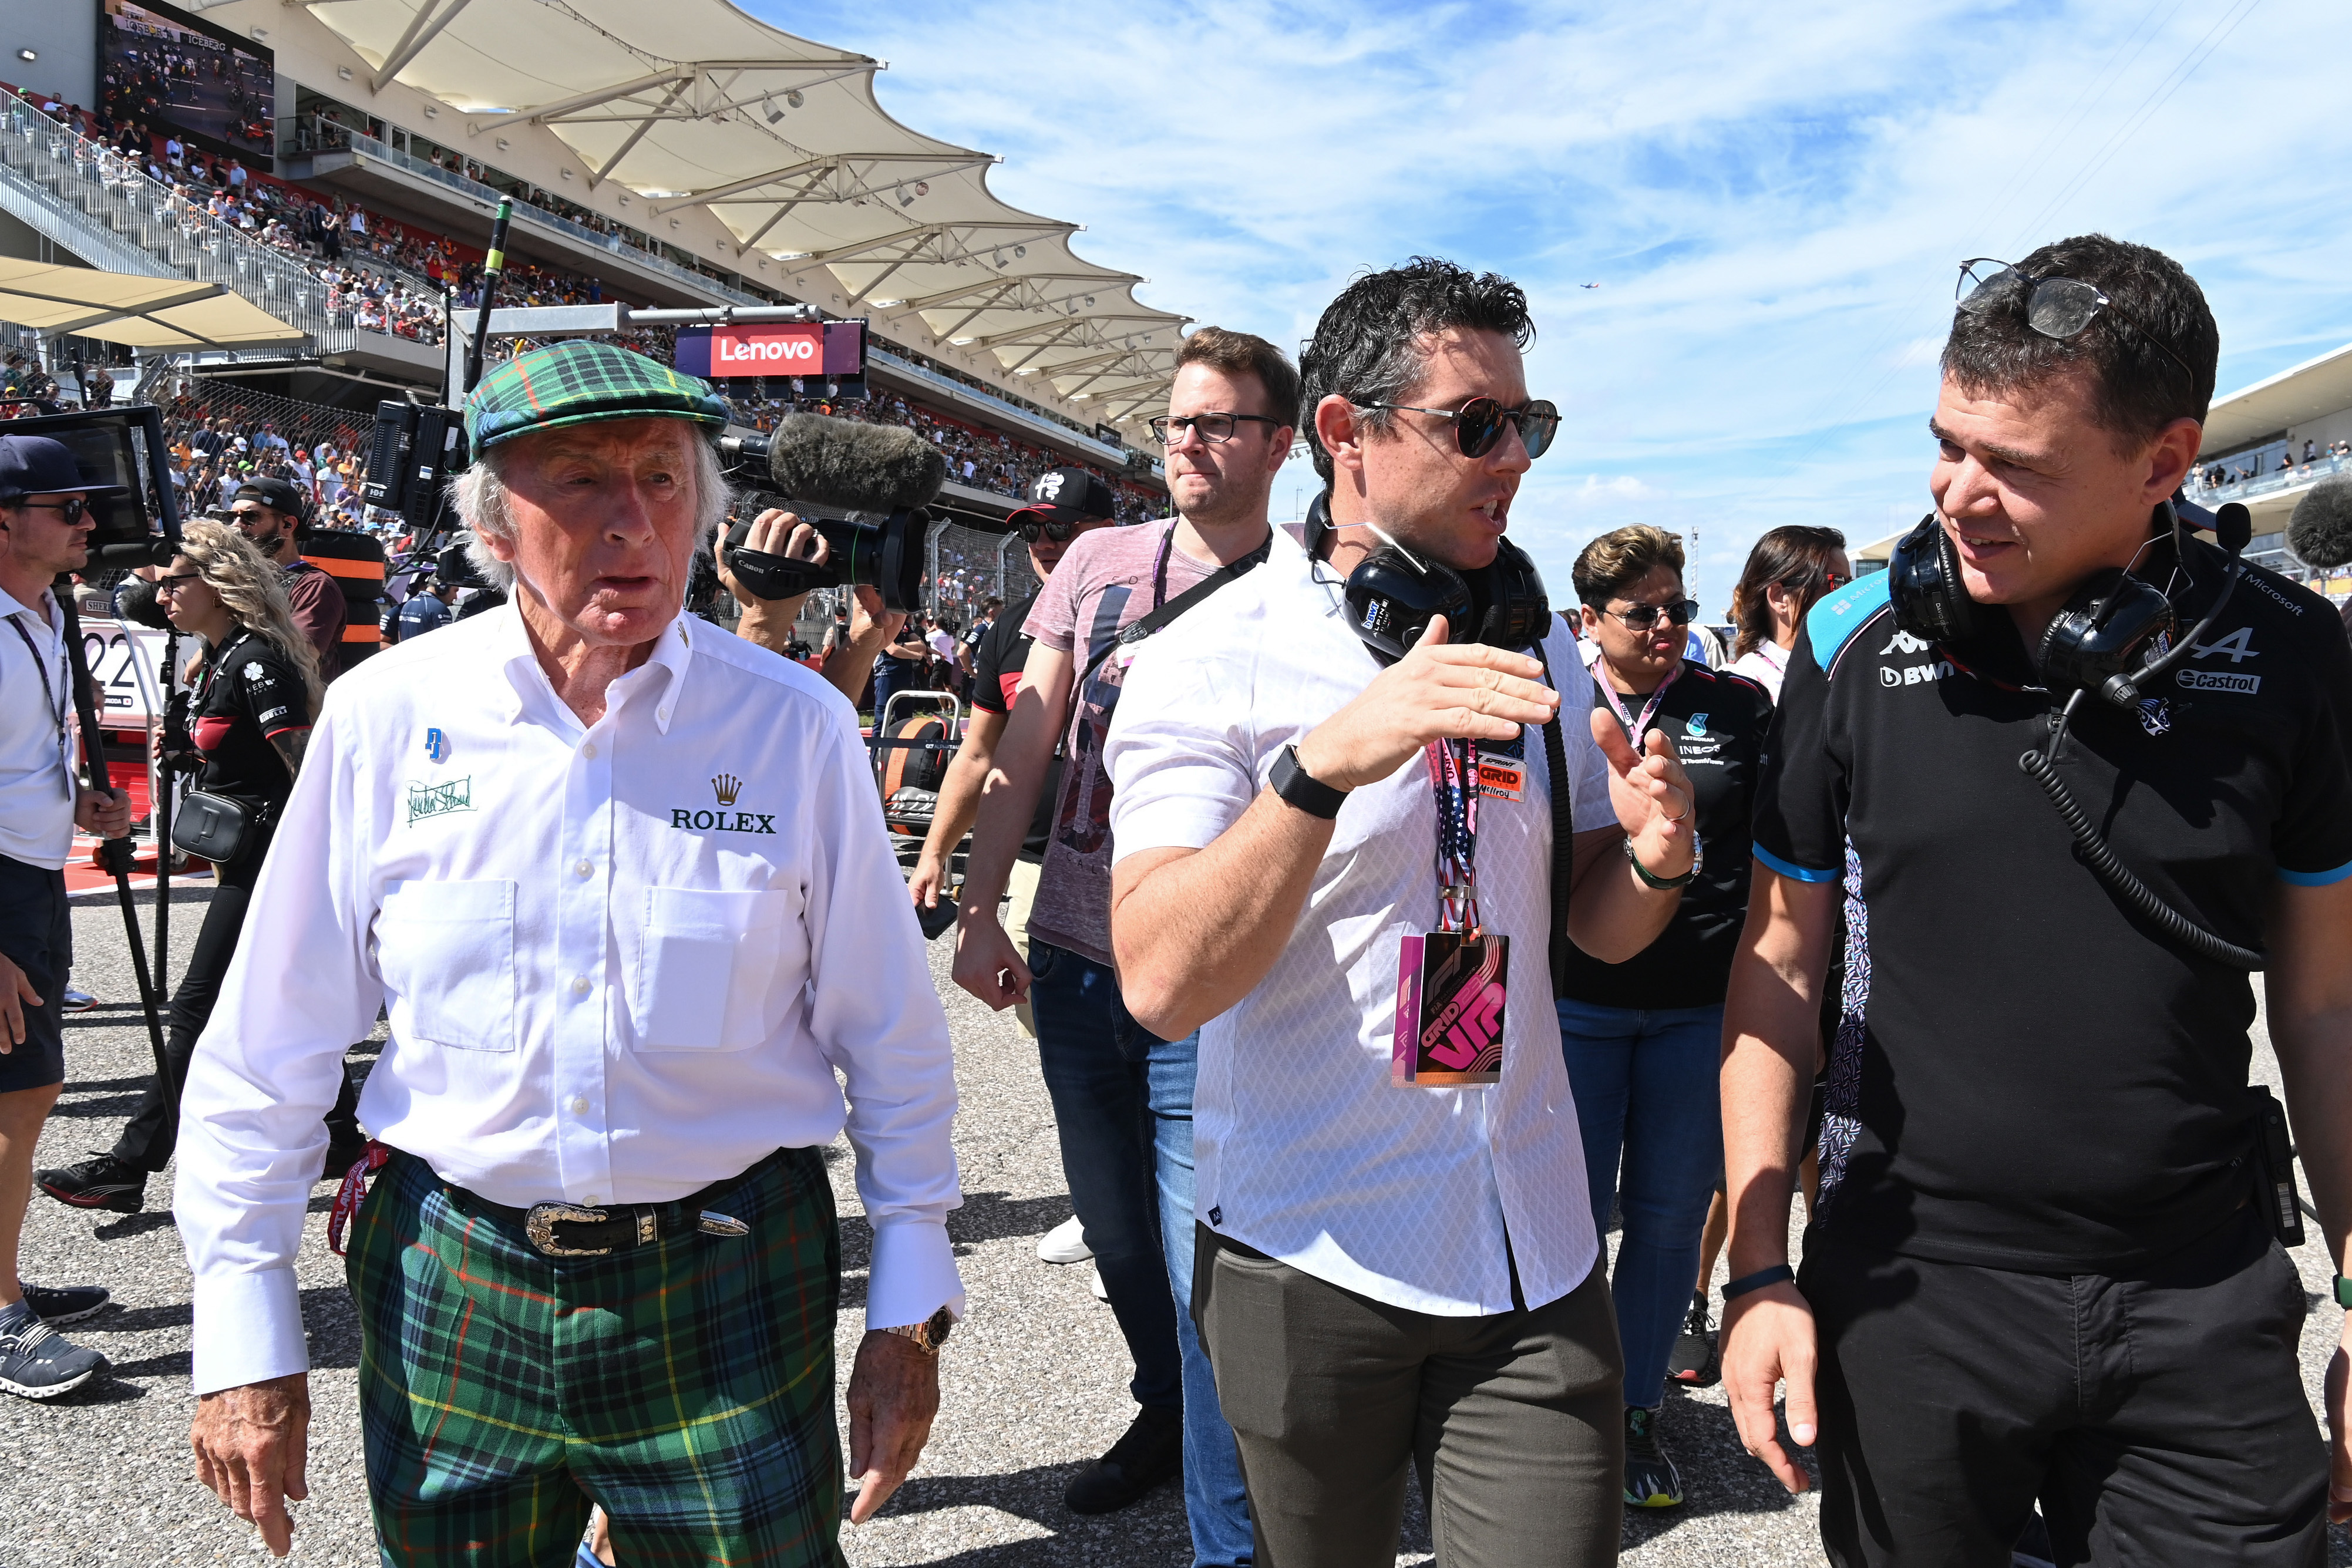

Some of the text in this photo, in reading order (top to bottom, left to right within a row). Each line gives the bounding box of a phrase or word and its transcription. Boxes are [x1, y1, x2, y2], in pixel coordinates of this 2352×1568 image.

[189, 35, 226, 52] ICEBERG
[721, 339, 813, 361] Lenovo
[738, 560, 764, 574] Canon
[2245, 574, 2303, 616] Microsoft
[1367, 601, 1379, 622] BWT
[1373, 600, 1388, 638] ALPINE
[1936, 603, 1944, 619] DAVID
[2196, 674, 2254, 691] Castrol
[258, 706, 287, 723] PIRELLI
[1621, 705, 1631, 721] GRID
[1679, 744, 1721, 755] INEOS
[1483, 758, 1516, 768] SPRINT
[1479, 766, 1519, 785] GRID
[1481, 779, 1514, 789] ACCESS
[670, 809, 777, 834] ROLEX
[1421, 1001, 1461, 1048] GRID
[1428, 982, 1506, 1069] VIP
[331, 1179, 355, 1236] PITLANE
